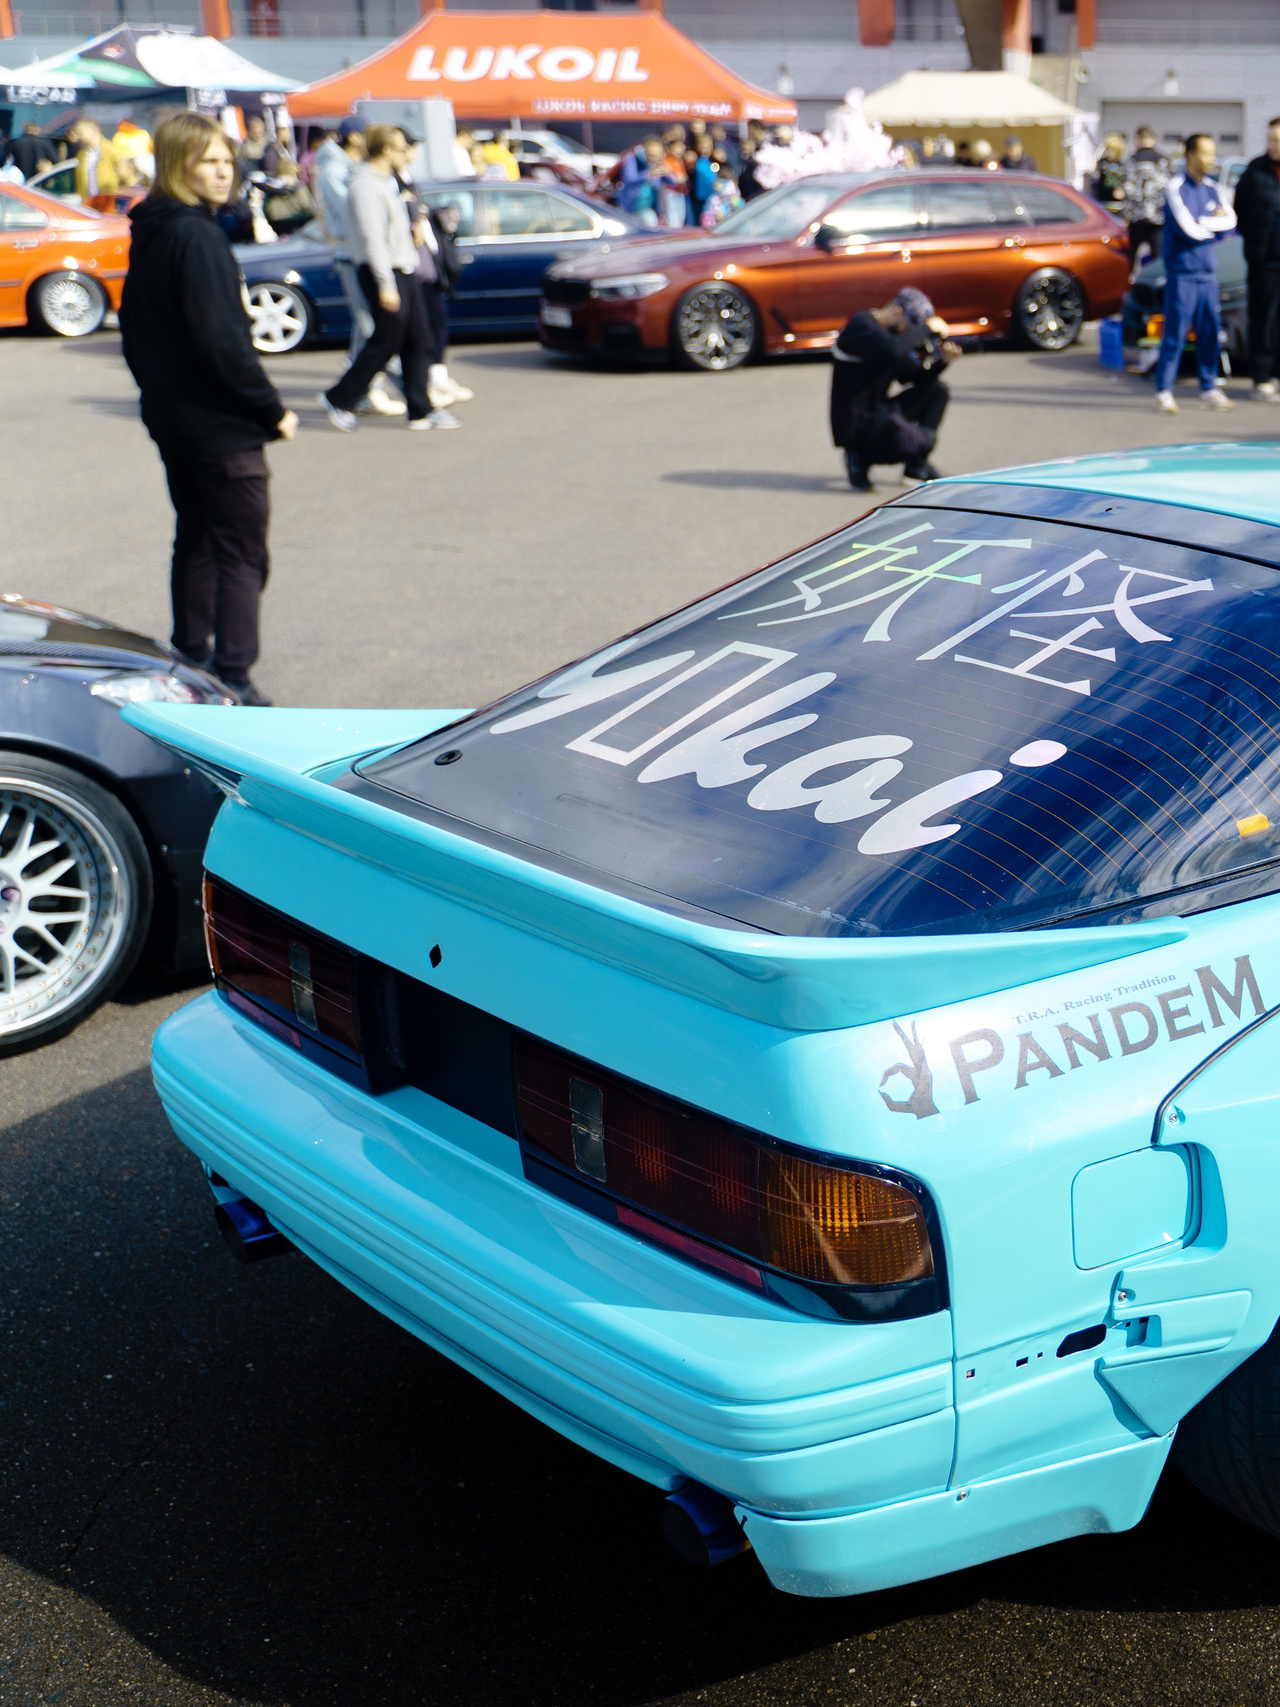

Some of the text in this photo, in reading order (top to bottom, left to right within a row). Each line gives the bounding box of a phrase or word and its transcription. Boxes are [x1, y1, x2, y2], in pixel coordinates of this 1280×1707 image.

[406, 44, 649, 83] LUKOIL
[1012, 972, 1177, 1025] T.R.A. Racing Tradition
[948, 954, 1268, 1106] PANDEM
